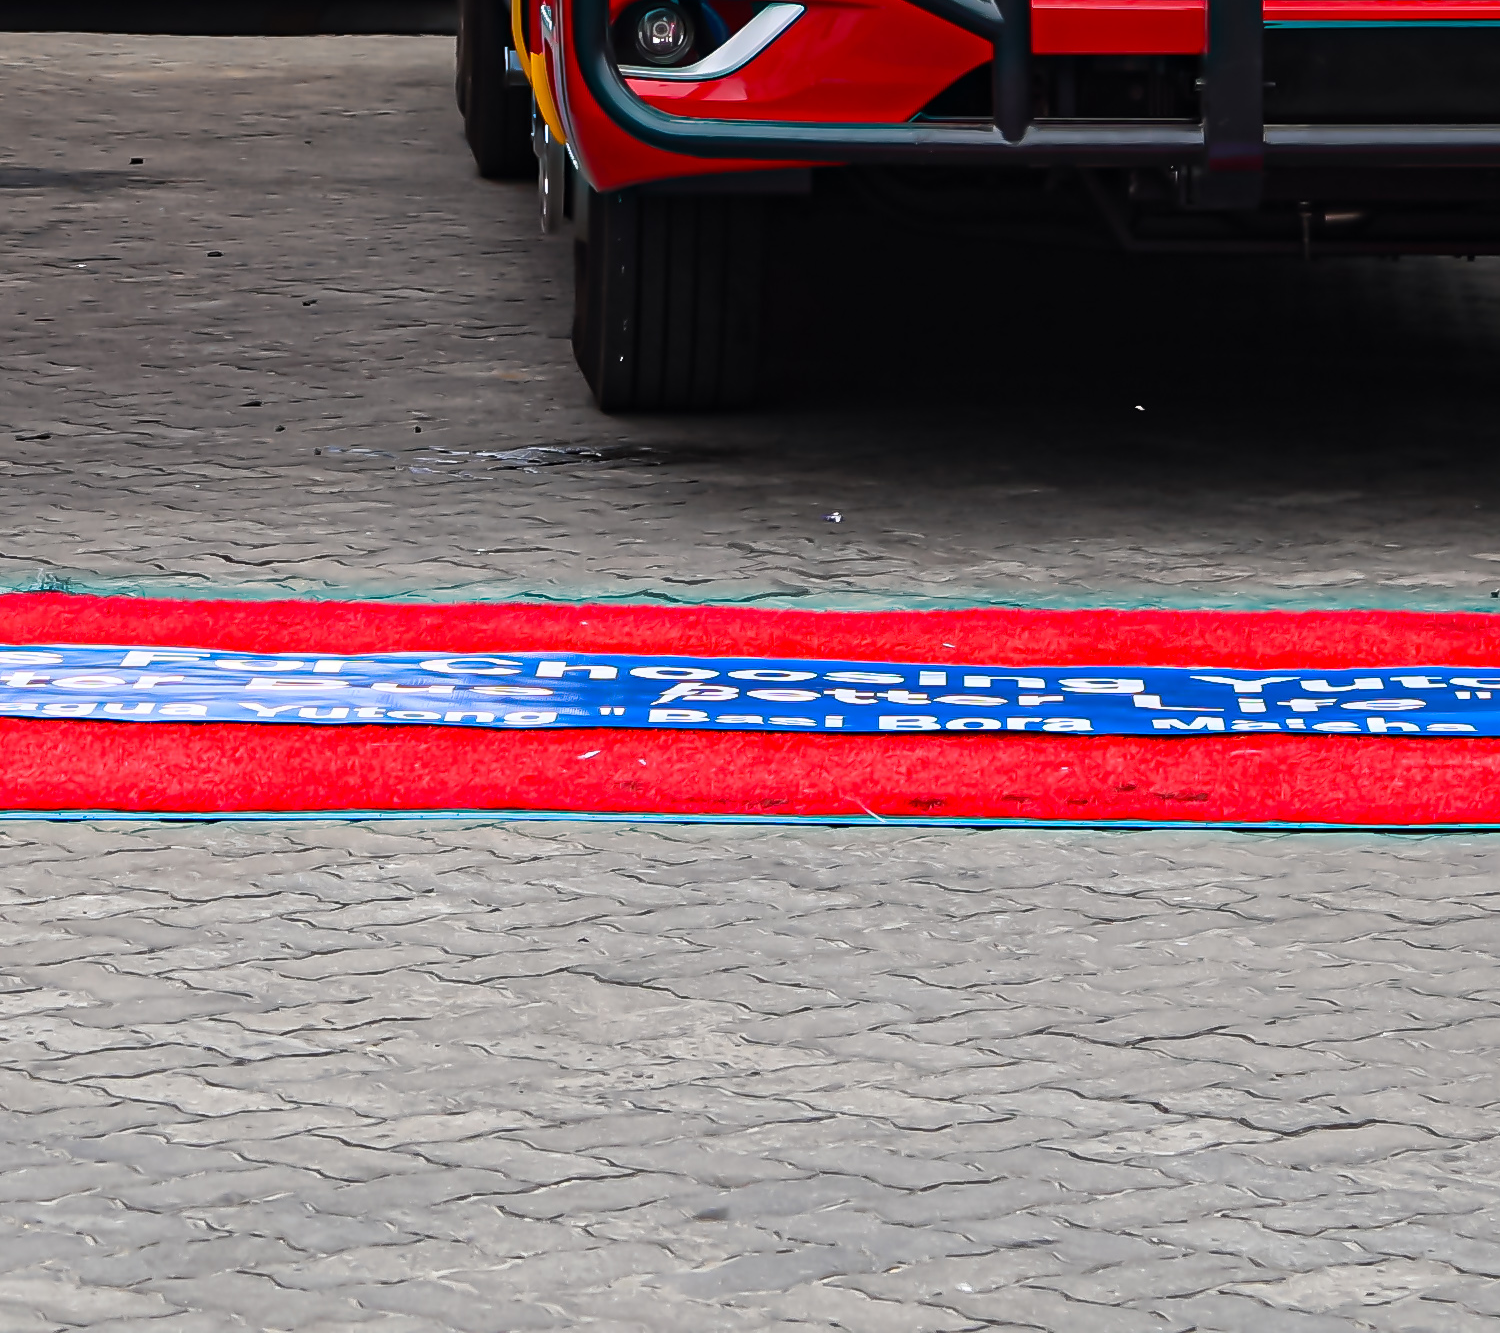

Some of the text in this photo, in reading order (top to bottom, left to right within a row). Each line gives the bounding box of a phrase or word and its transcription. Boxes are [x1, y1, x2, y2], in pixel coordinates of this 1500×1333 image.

[119, 650, 377, 675] For
[419, 655, 1145, 695] Choosing
[238, 702, 560, 726] Yutong
[877, 714, 1096, 733] Bora
[1150, 714, 1480, 733] Maisha
